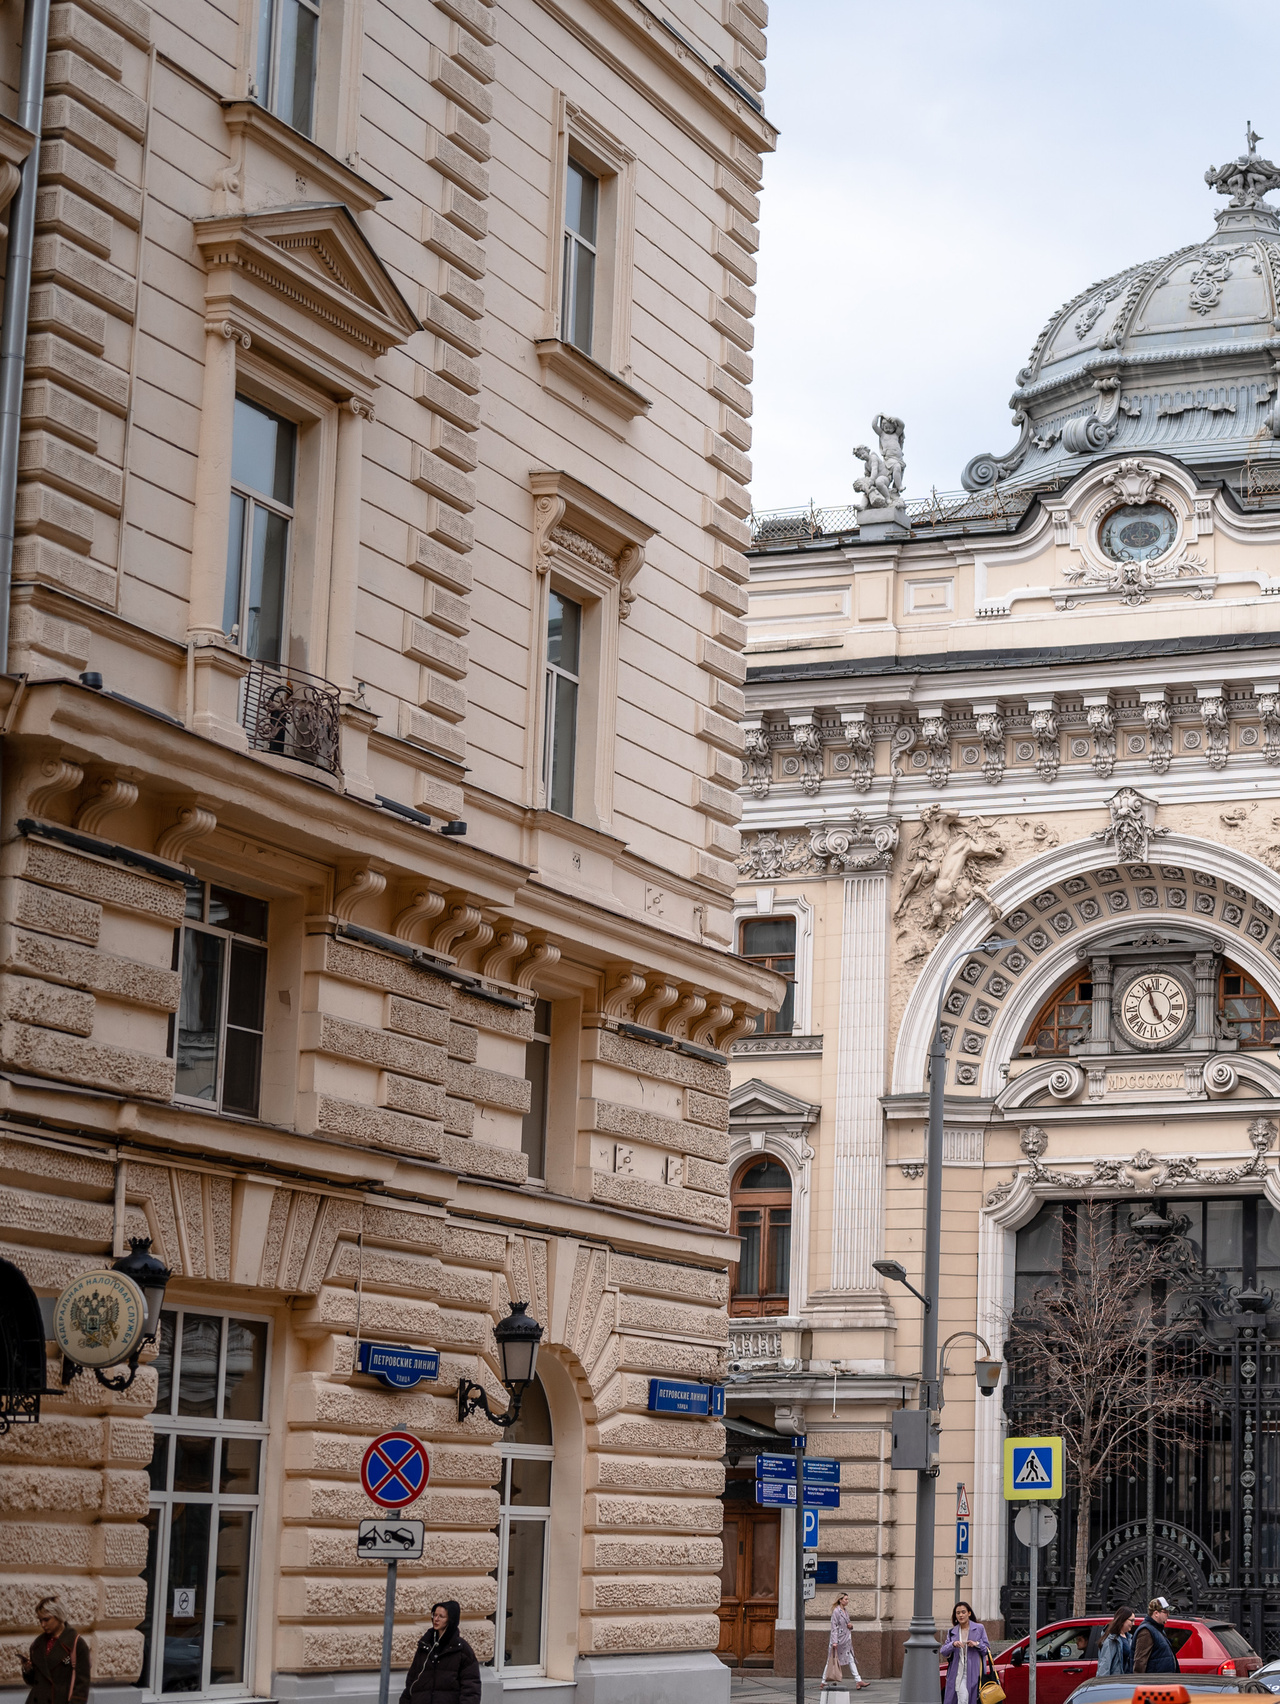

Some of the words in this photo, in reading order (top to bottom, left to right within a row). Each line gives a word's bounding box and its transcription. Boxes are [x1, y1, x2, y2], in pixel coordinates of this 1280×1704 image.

[1107, 1072, 1184, 1091] MDCCCXCV
[58, 1283, 84, 1346] ФЕДЕРАЛЬНАЯ
[86, 1277, 132, 1304] НАЛОГОВАЯ
[121, 1305, 136, 1344] СЛУЖБА
[373, 1354, 413, 1369] ПЕТРОВСКИЕ
[413, 1359, 436, 1371] ЛИНИИ
[396, 1374, 411, 1383] УЛИЦА
[659, 1388, 690, 1400] ПЕТРОВСКИЕ
[690, 1392, 707, 1402] ЛИНИИ
[716, 1392, 721, 1410] 1
[803, 1511, 815, 1543] P
[959, 1524, 968, 1551] P
